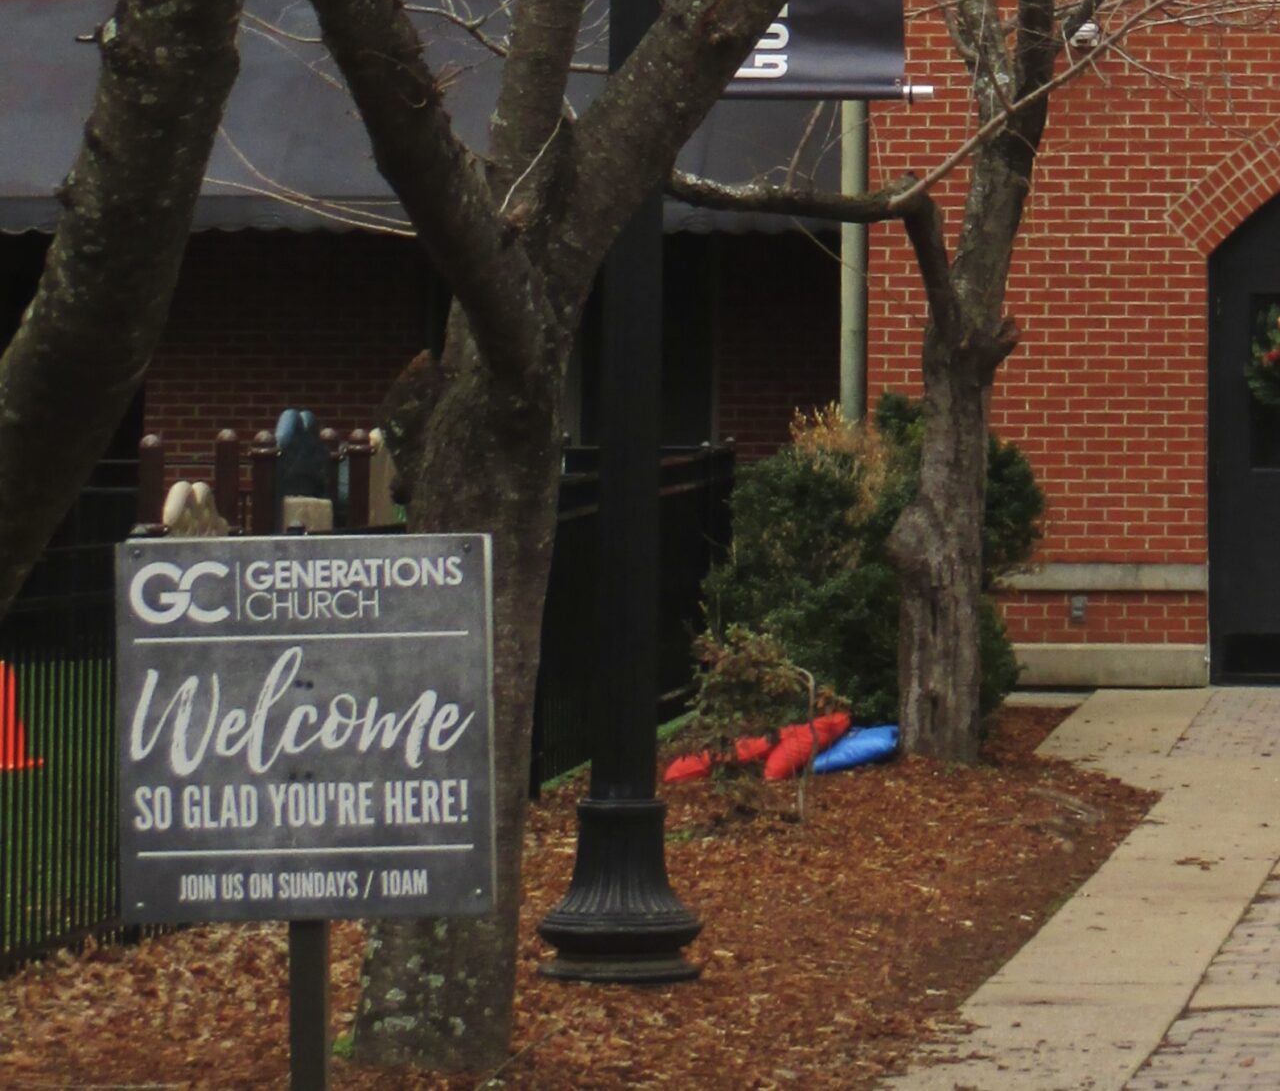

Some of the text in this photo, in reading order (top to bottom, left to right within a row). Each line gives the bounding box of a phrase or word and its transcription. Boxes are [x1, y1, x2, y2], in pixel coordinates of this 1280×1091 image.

[129, 561, 230, 624] GC
[245, 556, 463, 590] GENERATIONS
[245, 589, 379, 621] CHURCH
[129, 646, 475, 776] Welcome
[134, 779, 469, 830] SO GLAD YOU'RE HERE!
[179, 869, 428, 901] JOIN US ON SUNDAYS / 10AM
